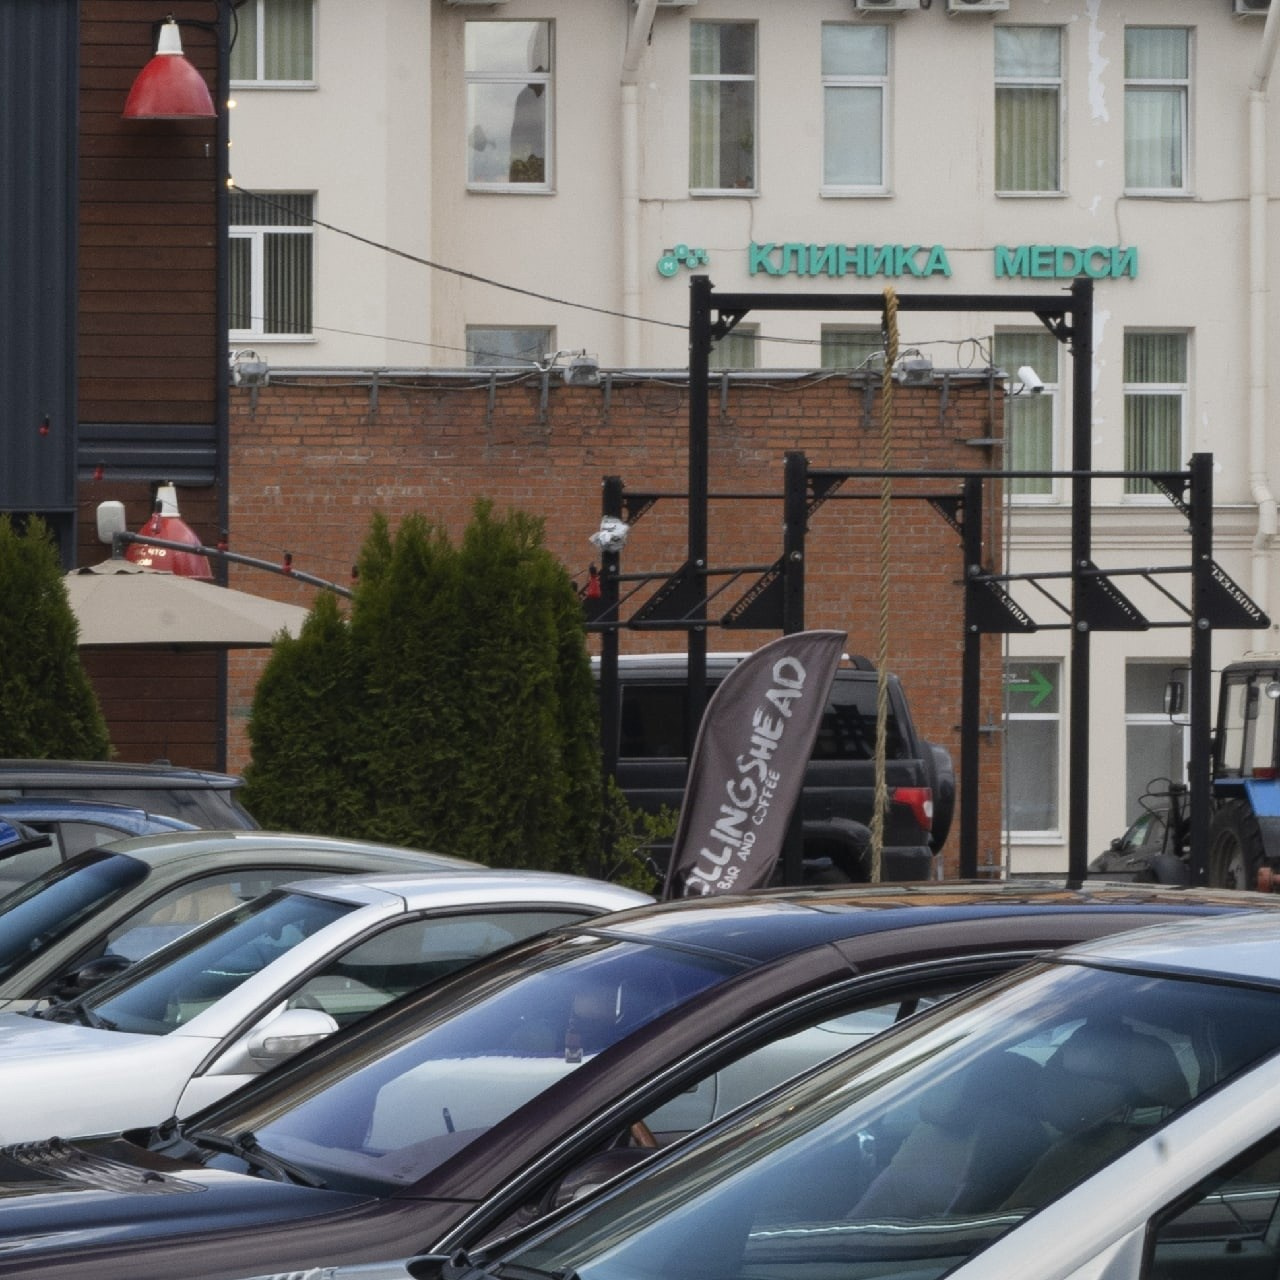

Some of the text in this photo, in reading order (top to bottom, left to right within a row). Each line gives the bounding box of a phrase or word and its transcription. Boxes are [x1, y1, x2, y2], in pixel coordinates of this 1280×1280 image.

[748, 241, 953, 278] КЛИНИКА
[716, 769, 781, 891] BAR AND COFFEE
